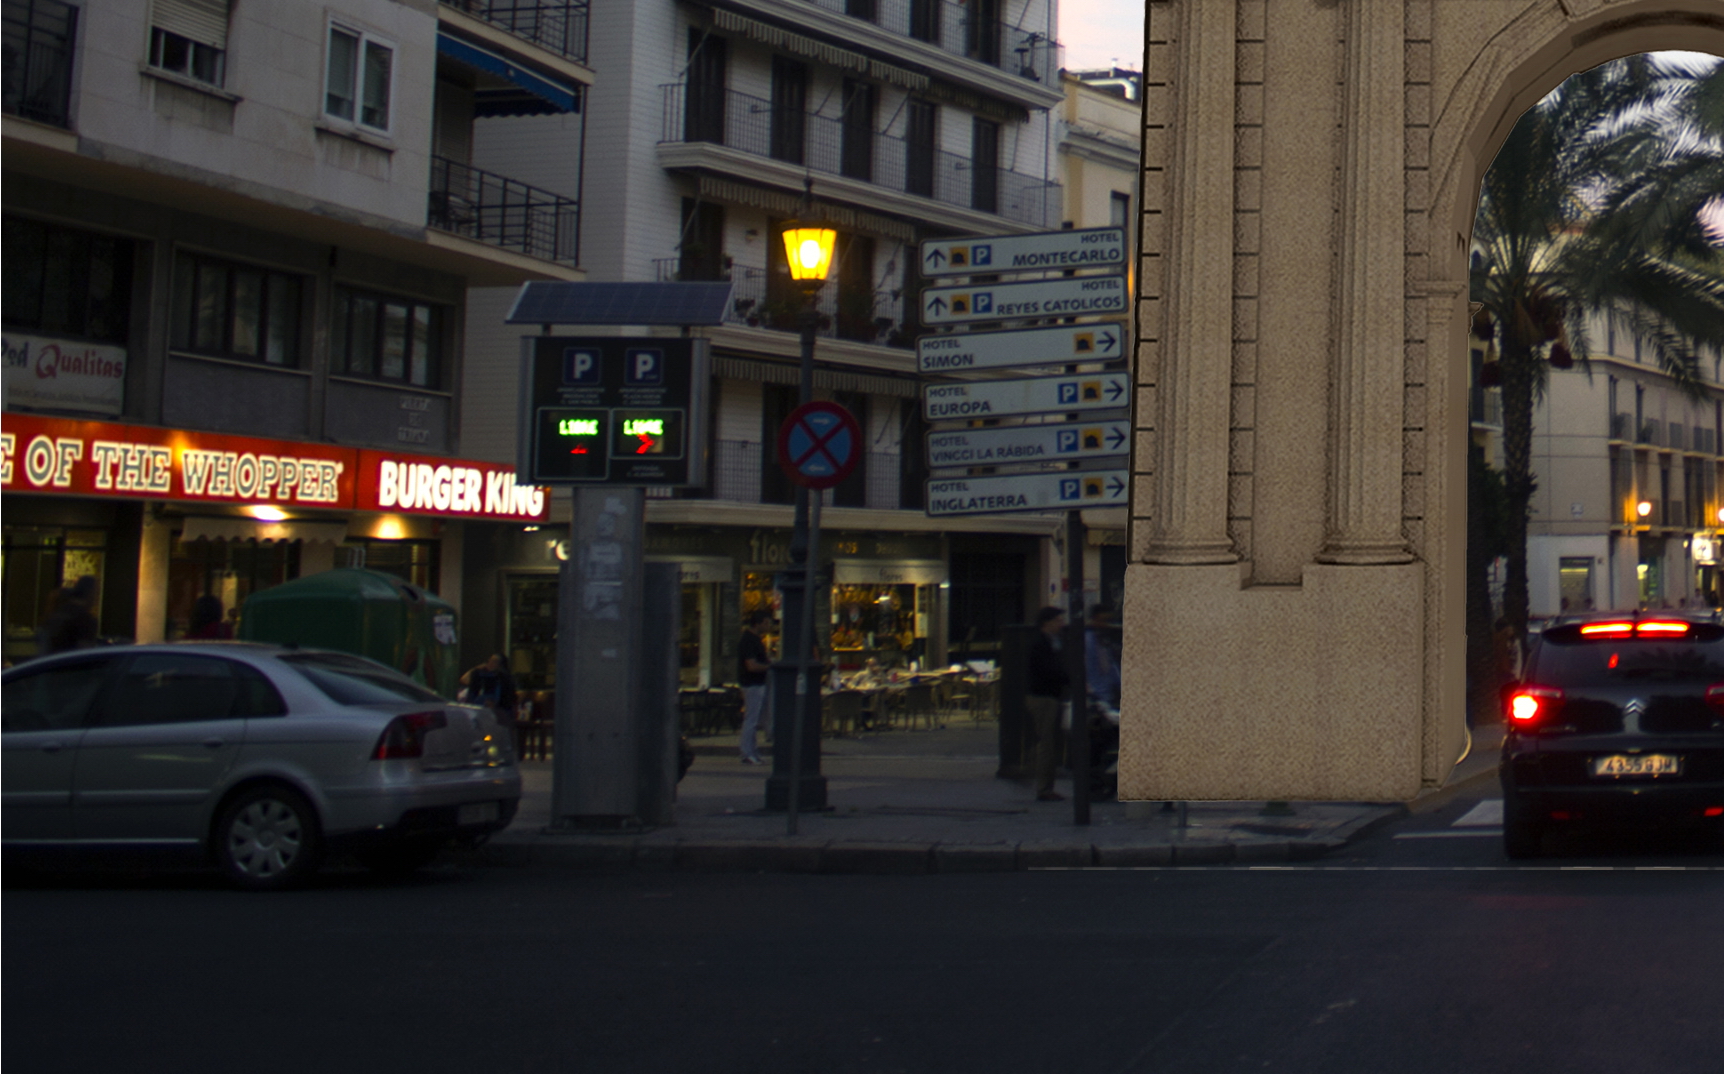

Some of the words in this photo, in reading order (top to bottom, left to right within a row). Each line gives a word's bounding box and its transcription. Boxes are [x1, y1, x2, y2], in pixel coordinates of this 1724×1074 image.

[1081, 232, 1120, 244] HOTEL
[1012, 248, 1121, 268] MONTECARLO
[1081, 280, 1120, 291] HOTEL
[997, 302, 1039, 316] REYES
[1043, 297, 1121, 313] CATOLICOS
[922, 339, 960, 350] HOTEL
[36, 344, 123, 379] Qualitas
[923, 354, 974, 368] SIMON
[929, 386, 967, 397] HOTEL
[930, 401, 991, 415] EUROPA
[931, 436, 969, 446] HOTEL
[932, 449, 978, 463] VINCCI
[980, 448, 993, 461] LA
[997, 444, 1044, 458] RÁBIDA
[26, 435, 83, 487] OF
[92, 441, 172, 493] THE
[181, 450, 339, 503] WHOPPER
[379, 460, 483, 513] BURGER
[485, 471, 544, 516] KING
[931, 482, 969, 493] HOTEL
[932, 494, 1027, 511] INGLATERRA
